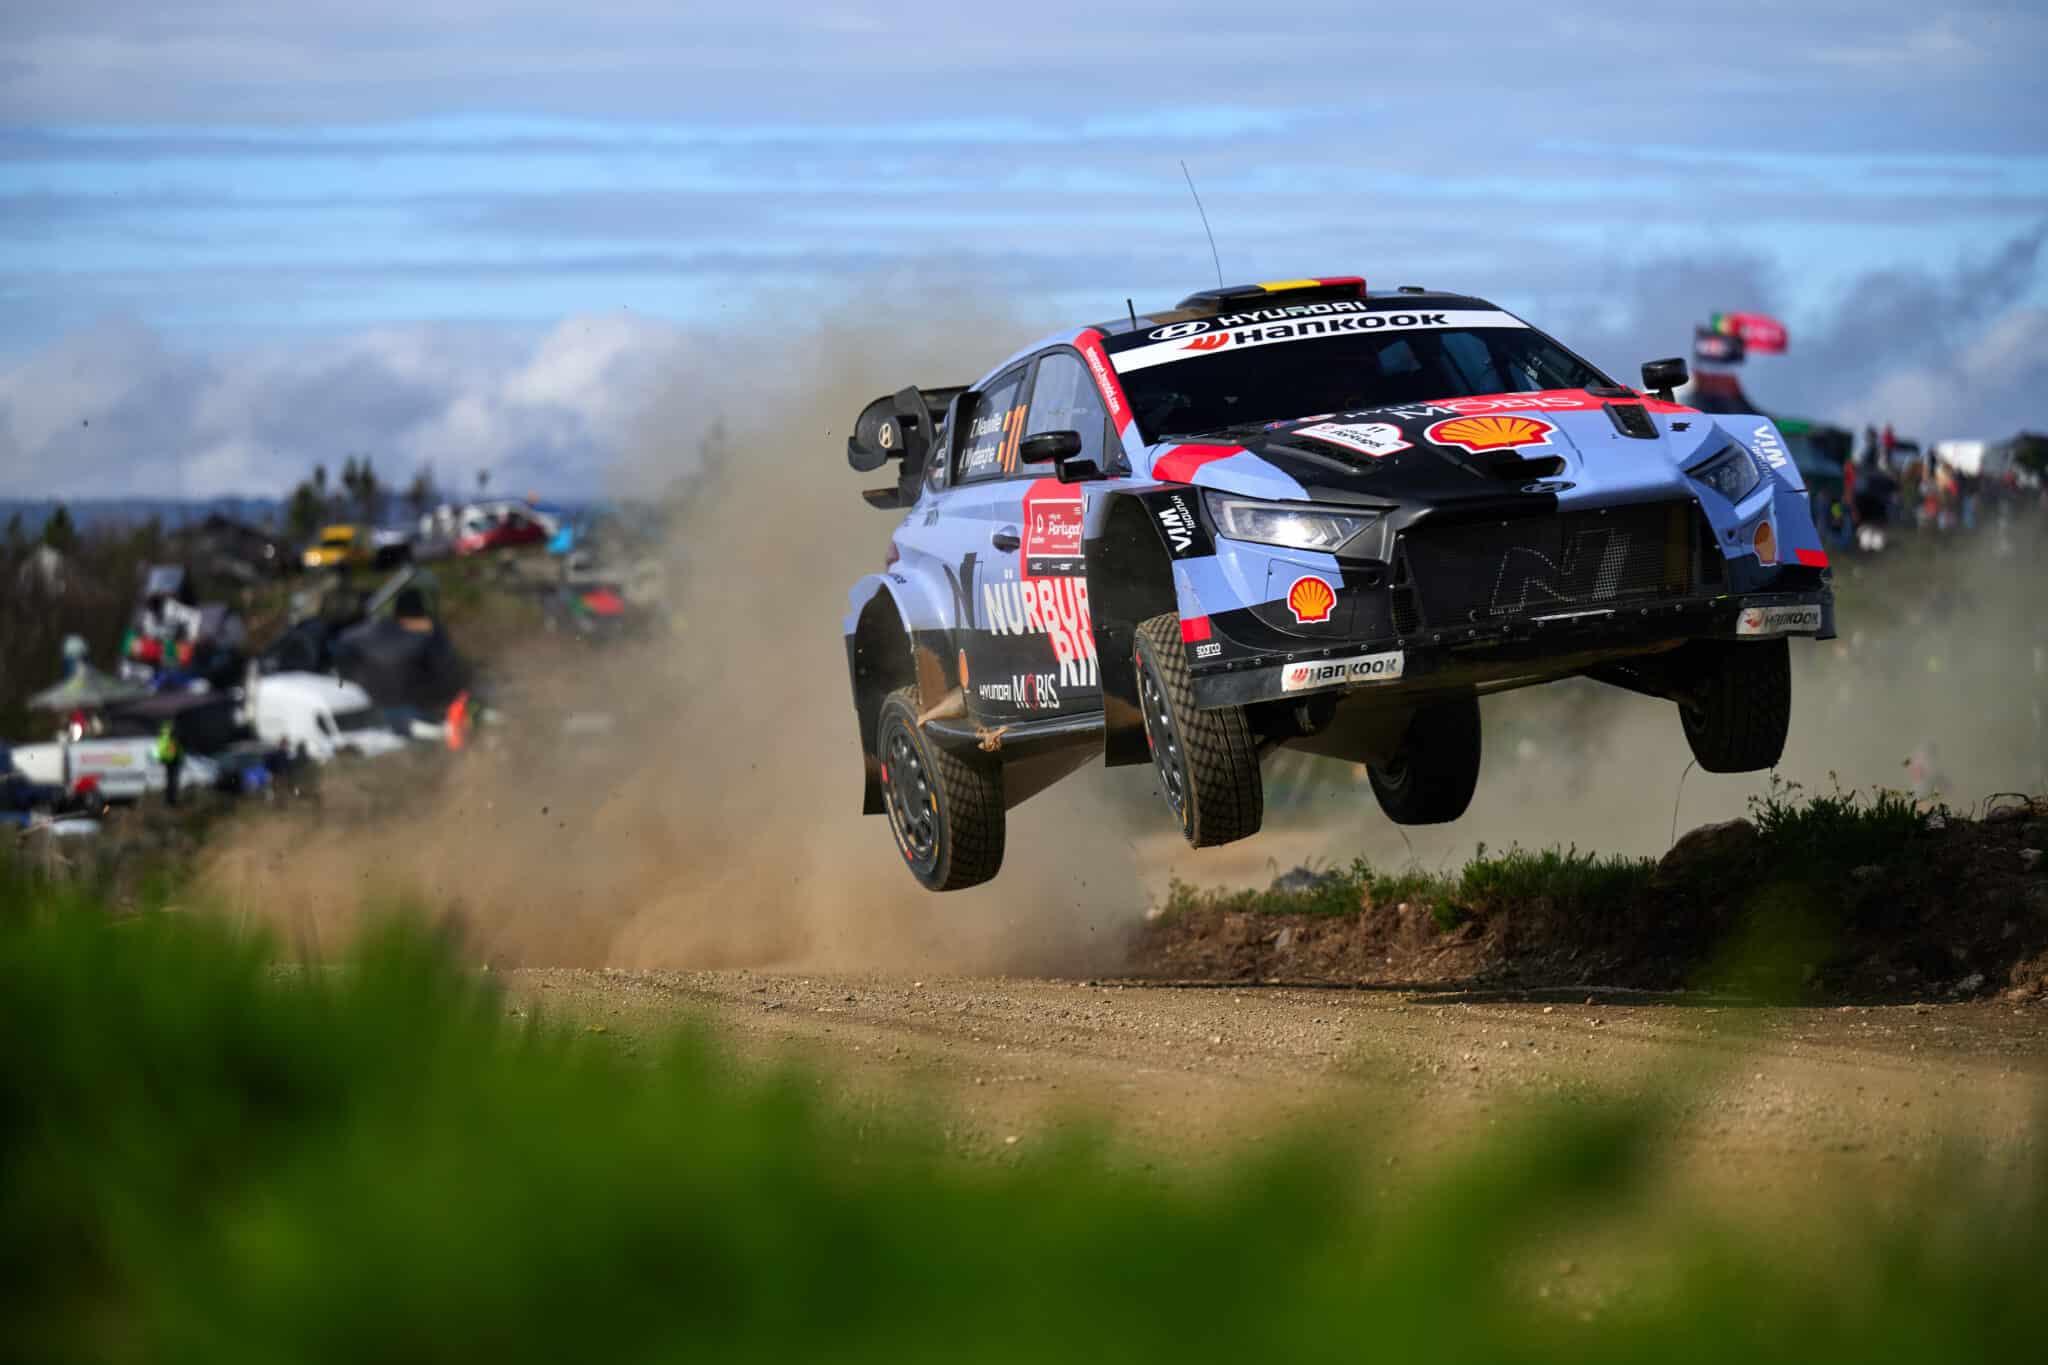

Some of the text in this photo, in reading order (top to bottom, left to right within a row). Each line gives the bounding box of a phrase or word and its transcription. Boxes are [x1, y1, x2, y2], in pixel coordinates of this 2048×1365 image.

[1217, 300, 1368, 327] HYUNDAI
[1391, 397, 1585, 420] MOBIS
[1170, 495, 1196, 529] HYUNDAI
[1047, 521, 1082, 539] Portugal
[1012, 672, 1060, 711] MOBIS
